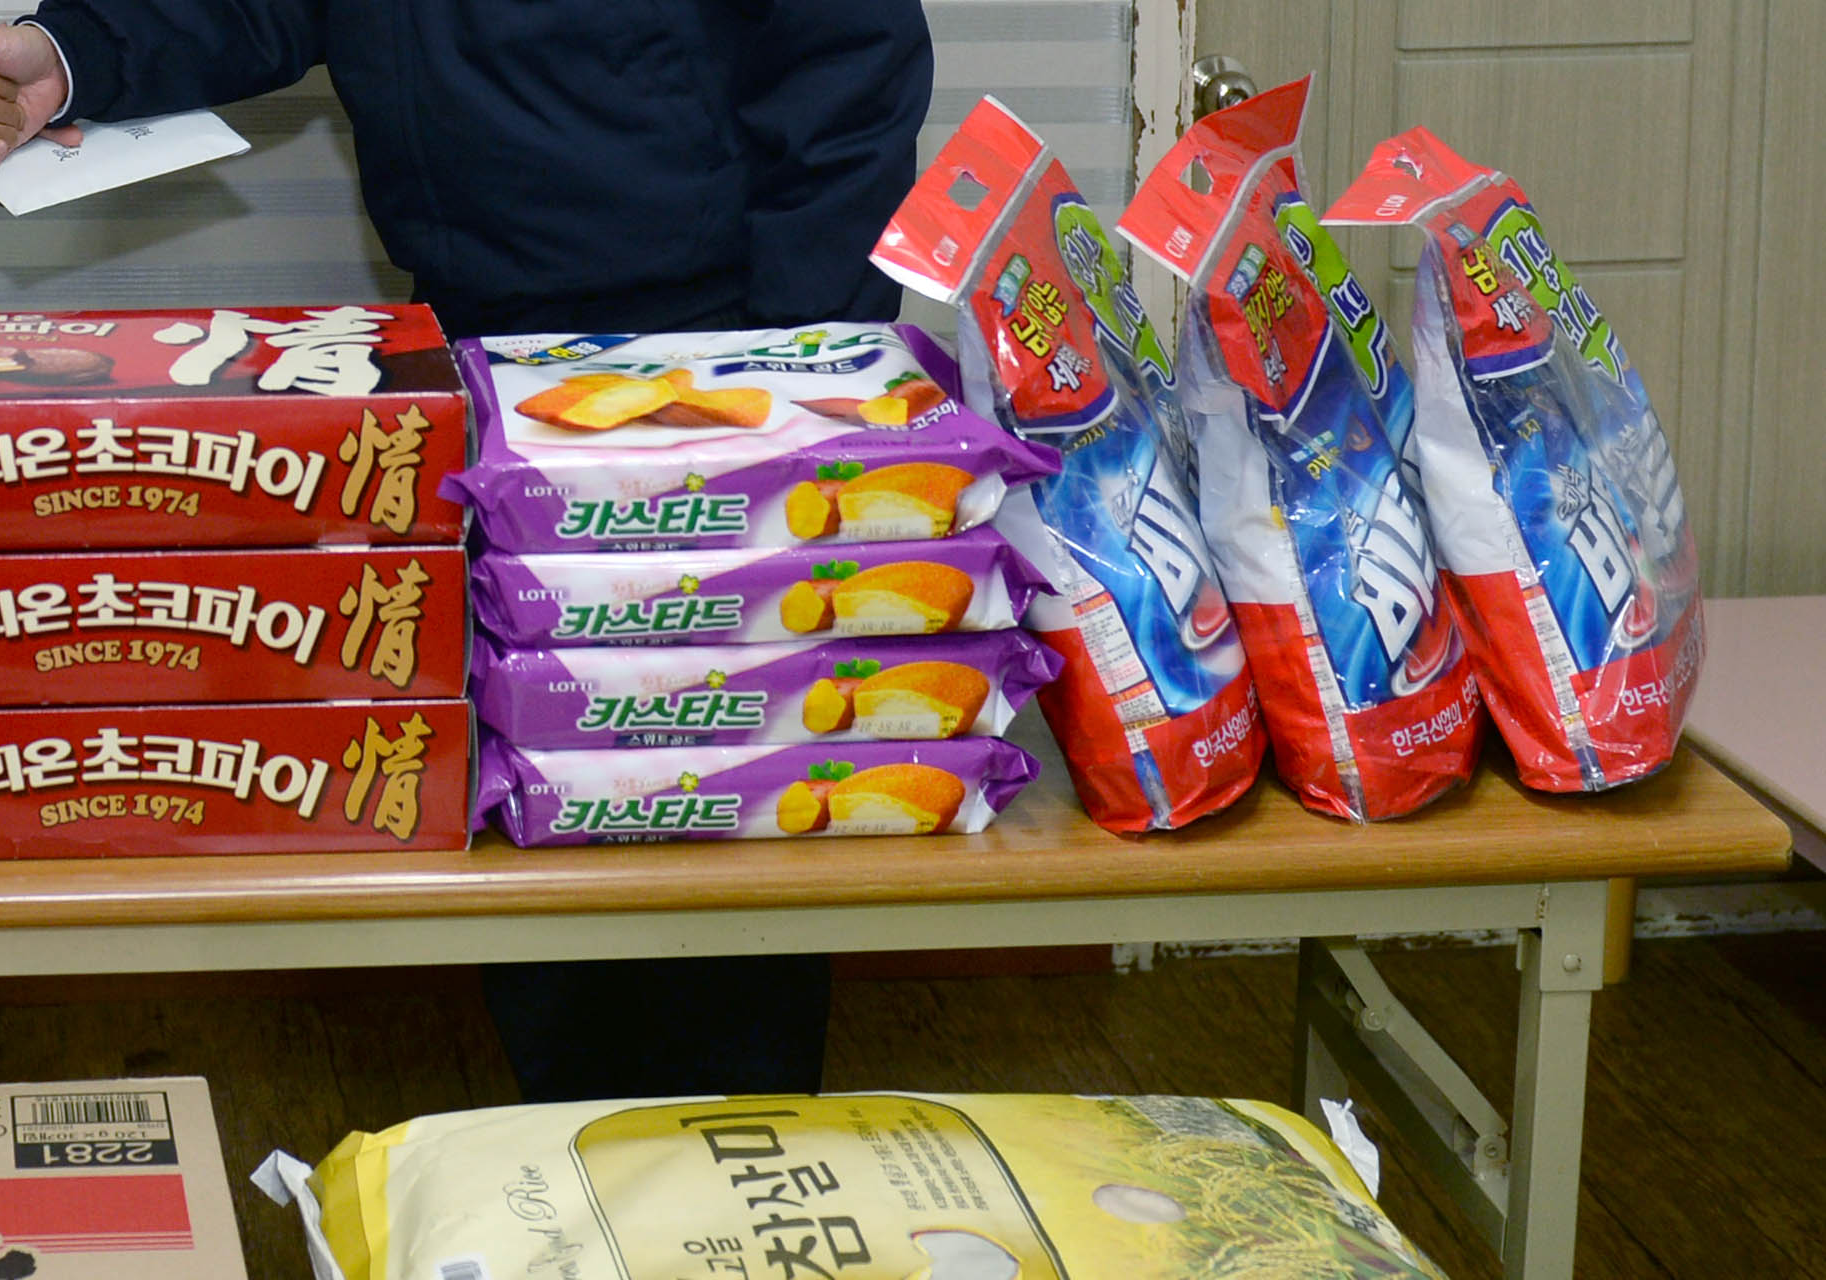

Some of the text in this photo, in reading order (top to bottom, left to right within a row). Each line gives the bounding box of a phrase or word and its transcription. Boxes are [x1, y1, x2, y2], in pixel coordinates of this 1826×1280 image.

[912, 399, 958, 431] 고구마
[74, 418, 326, 512] 초코파이
[34, 486, 201, 517] SINCE 1974
[557, 496, 747, 537] 카스타드
[77, 573, 326, 665] 초코파이
[554, 597, 741, 637] 카스타드
[35, 640, 201, 673] SINCE 1974
[580, 693, 765, 729] 카스타드
[1391, 704, 1462, 756] 한국산업의
[82, 728, 329, 819] 초코파이
[40, 795, 204, 827] SINCE 1974
[553, 797, 740, 832] 카스타드
[42, 1141, 154, 1165] 2281
